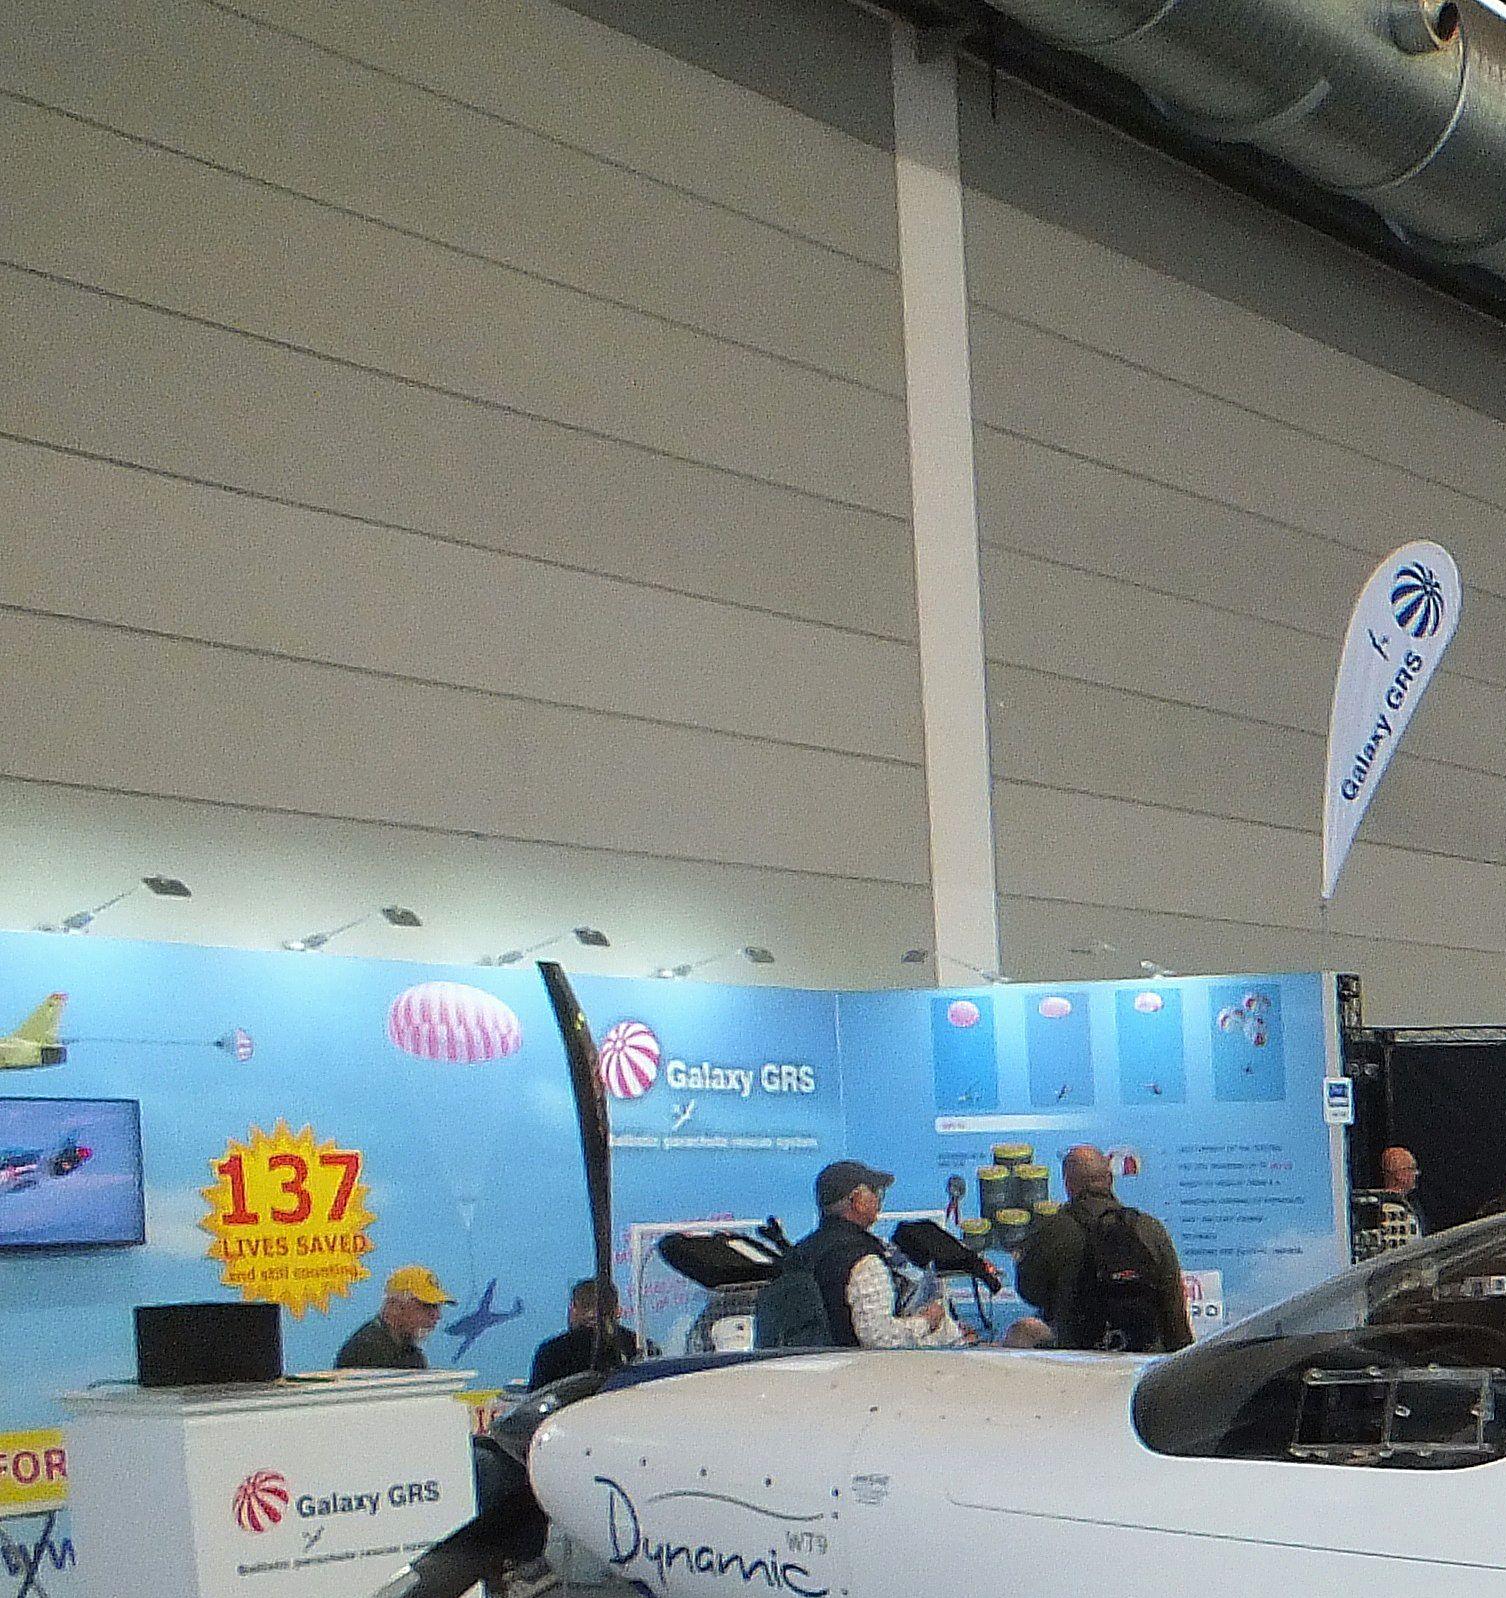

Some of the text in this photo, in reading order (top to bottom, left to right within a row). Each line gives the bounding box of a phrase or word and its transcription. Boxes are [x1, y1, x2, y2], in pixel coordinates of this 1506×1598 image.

[1340, 649, 1423, 801] Galaxy GRS
[666, 1060, 816, 1097] Galaxy GRS
[218, 1153, 361, 1226] 137
[219, 1235, 367, 1257] LIVES SAVED
[296, 1480, 441, 1518] Galaxy GRS
[594, 1476, 830, 1598] Dynamic
[785, 1529, 829, 1555] WT9
